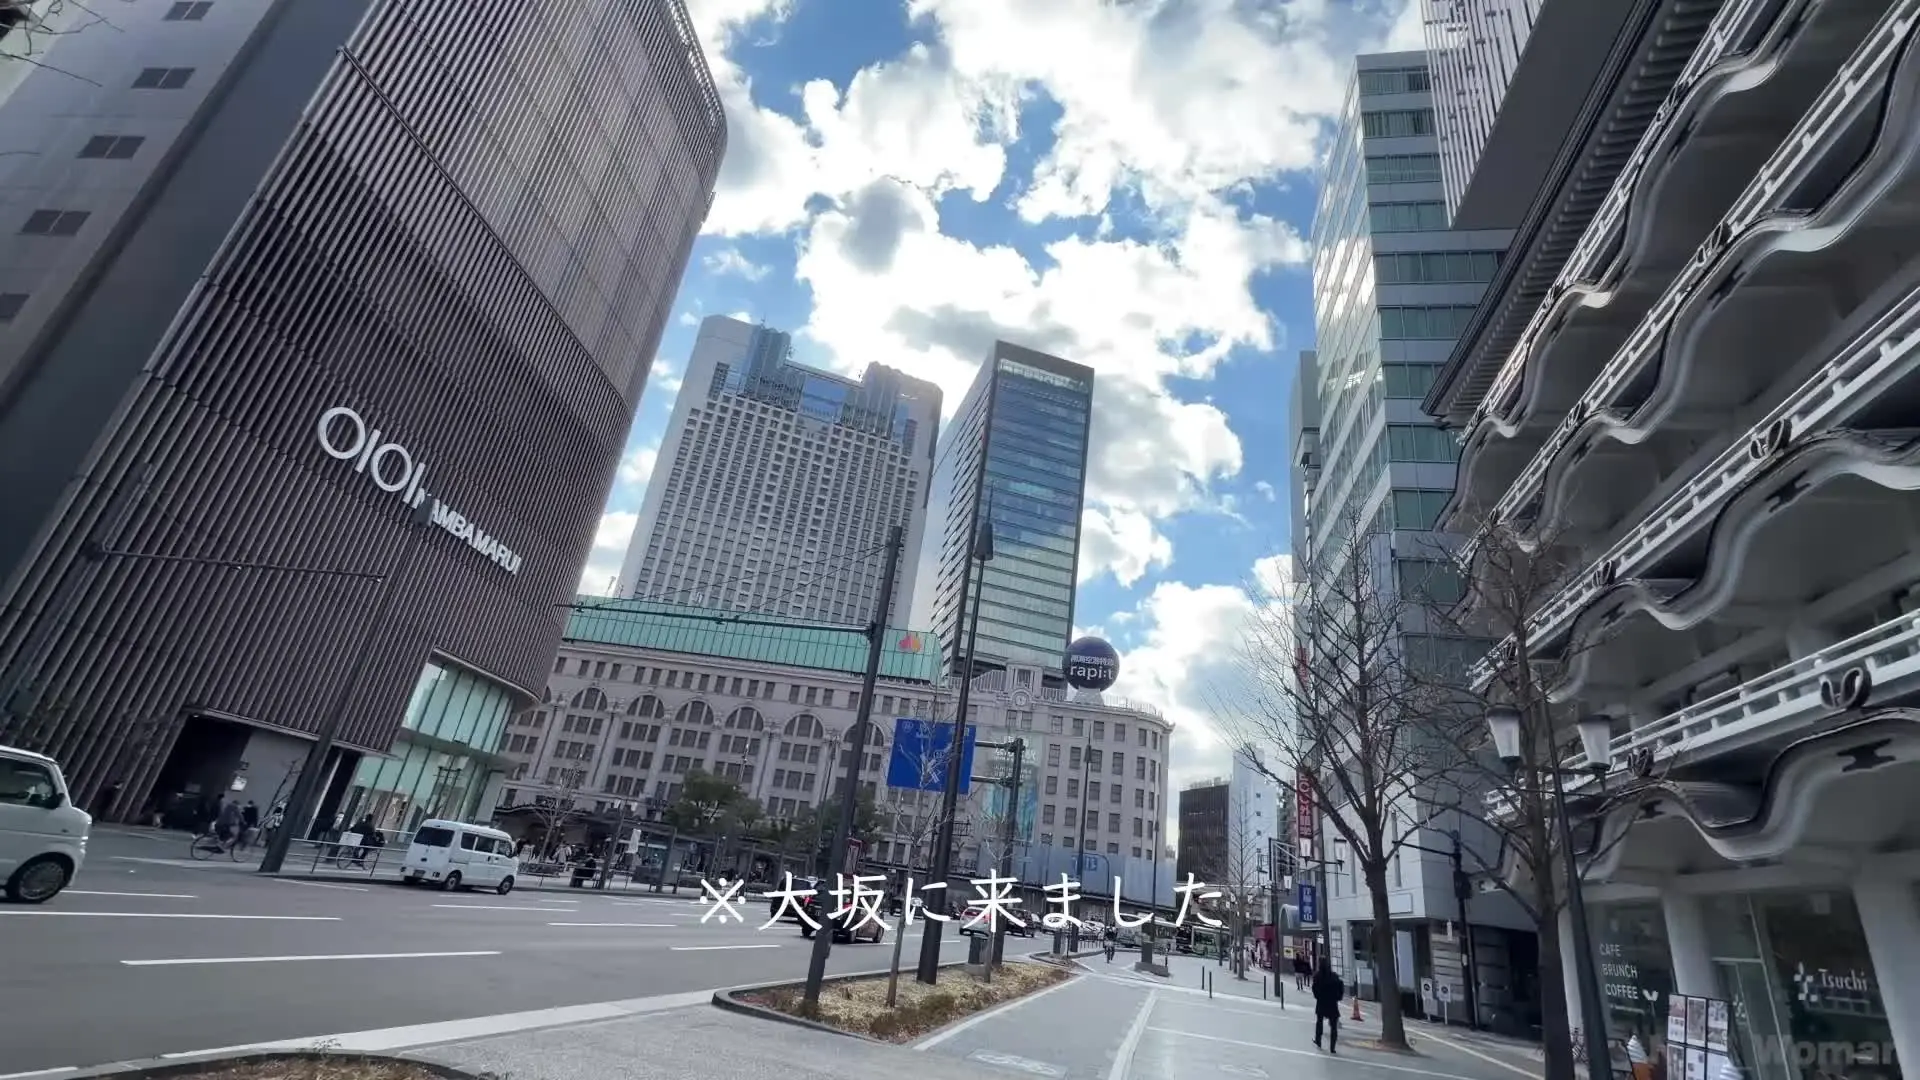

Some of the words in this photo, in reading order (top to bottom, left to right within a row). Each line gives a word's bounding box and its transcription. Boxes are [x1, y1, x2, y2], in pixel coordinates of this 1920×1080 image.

[1599, 943, 1622, 957] CAFE
[1602, 963, 1638, 979] BRUNCH
[1817, 967, 1868, 992] Tsuchi
[1606, 983, 1639, 999] COFFEE
